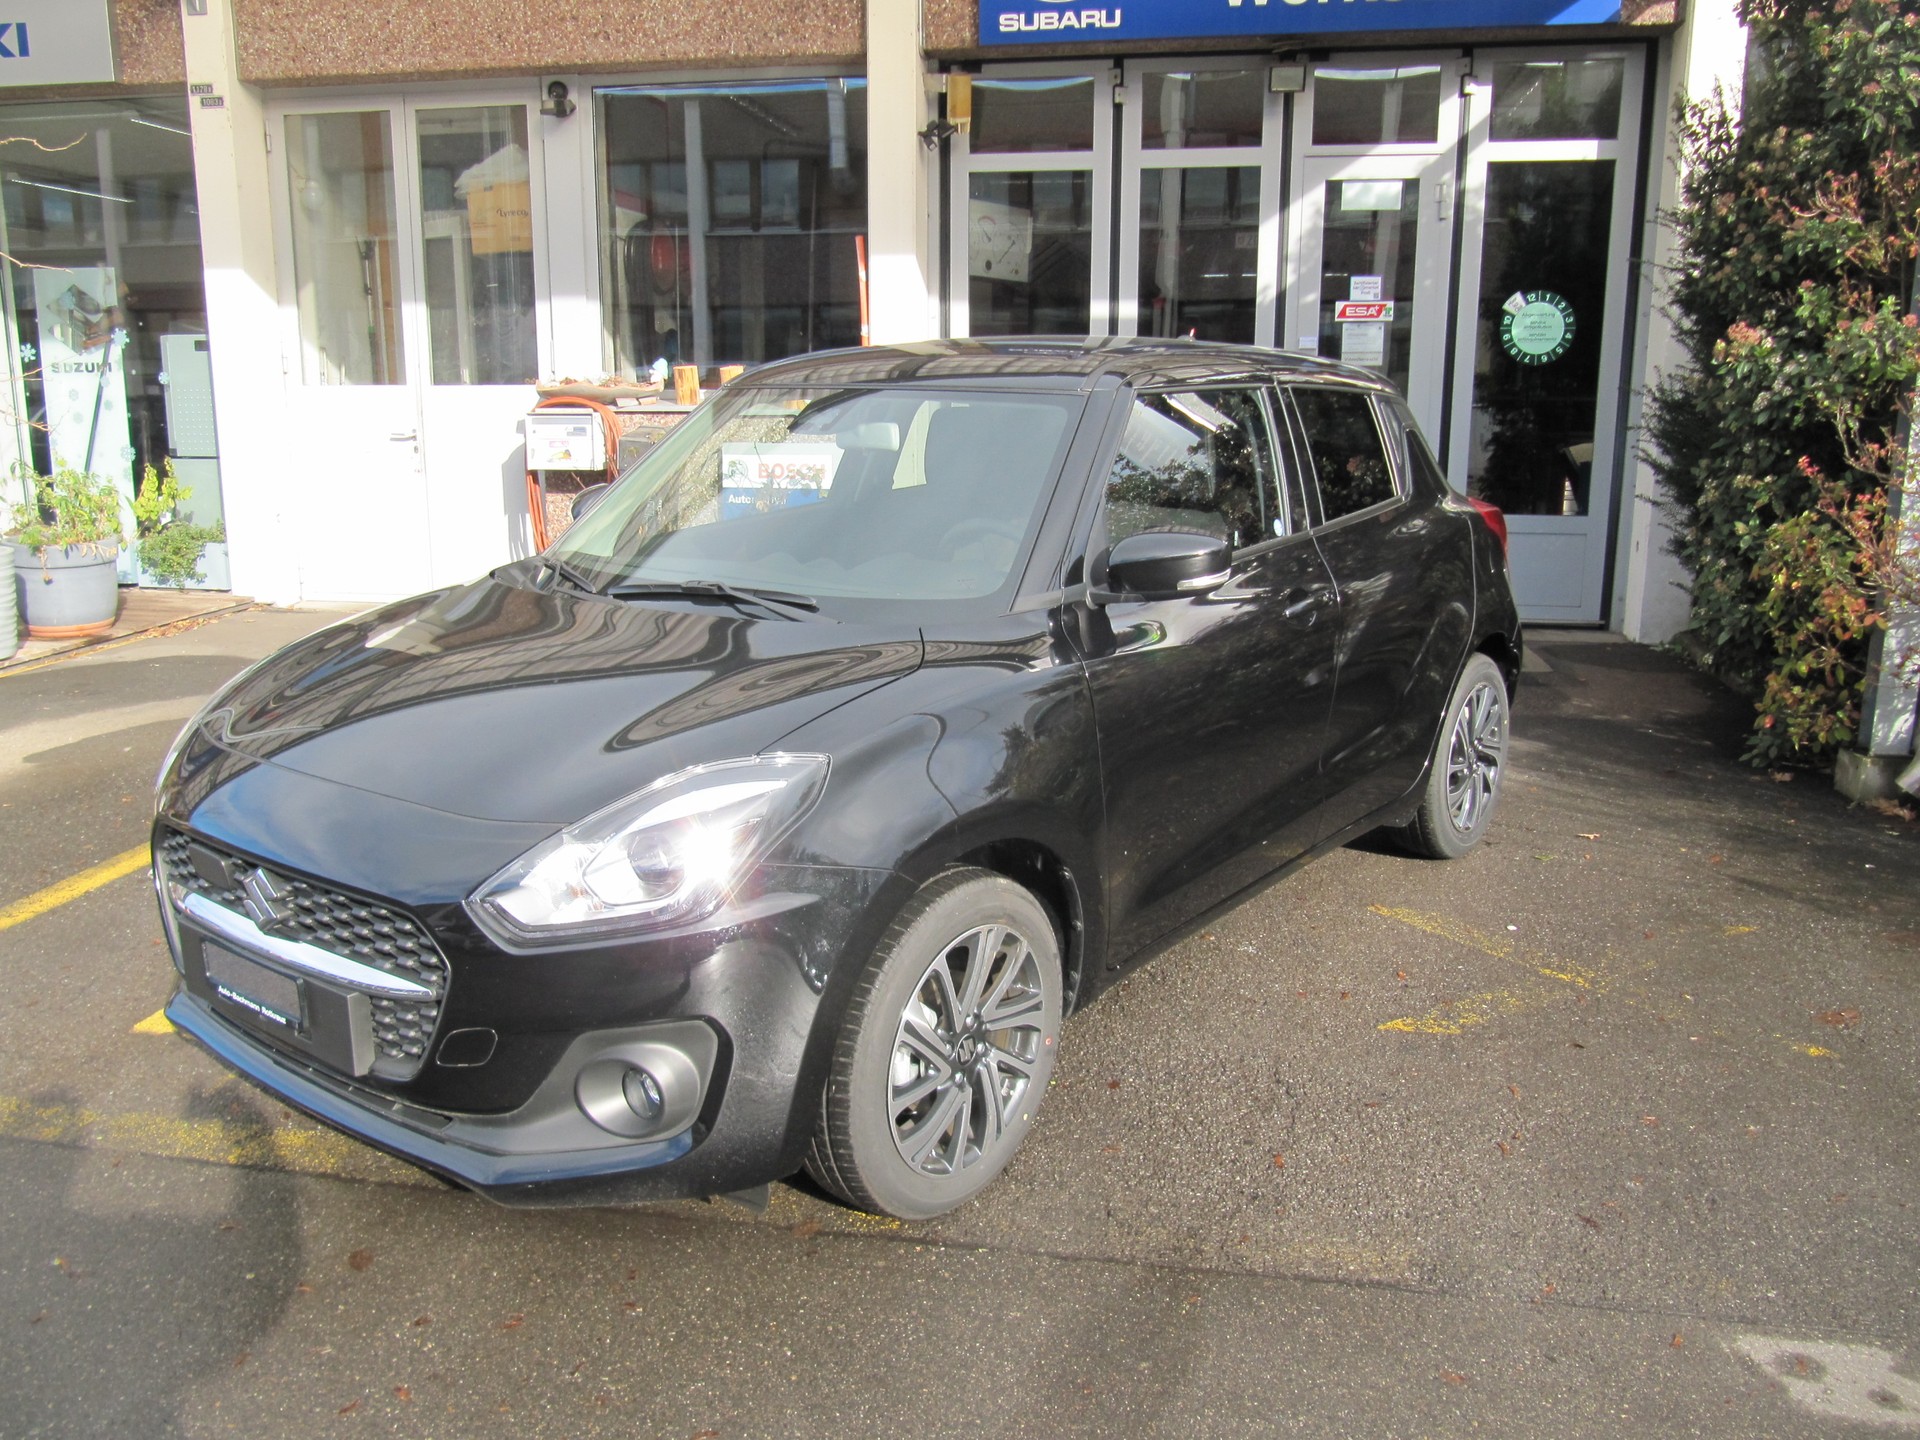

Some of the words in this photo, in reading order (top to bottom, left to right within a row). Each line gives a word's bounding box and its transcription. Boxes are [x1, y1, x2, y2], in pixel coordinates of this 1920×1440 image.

[999, 9, 1121, 32] SUBARU
[1527, 293, 1536, 302] 12
[1558, 302, 1566, 310] 2
[1504, 316, 1512, 325] 10
[1511, 347, 1518, 355] 8
[1556, 346, 1563, 354] 5
[1524, 355, 1530, 363] 7
